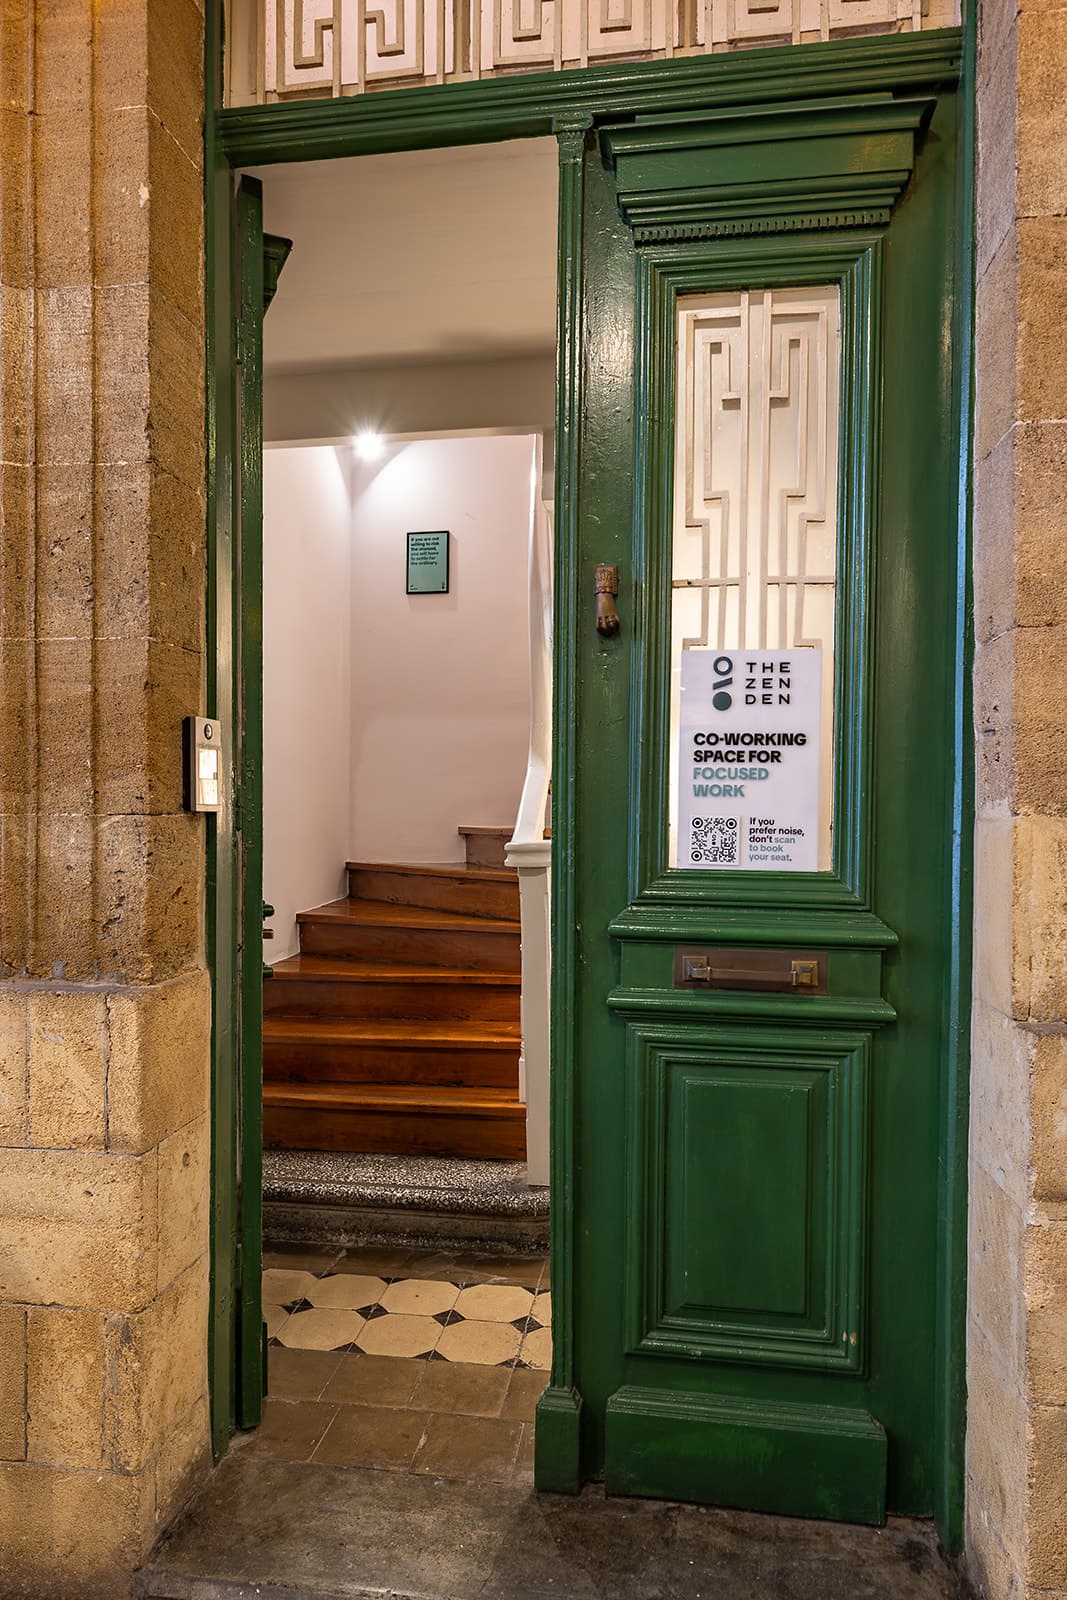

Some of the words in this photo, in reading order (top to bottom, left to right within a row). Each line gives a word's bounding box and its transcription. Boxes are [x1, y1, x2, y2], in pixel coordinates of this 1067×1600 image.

[746, 662, 790, 673] THE
[746, 678, 790, 689] ZEN
[745, 694, 790, 705] DEN
[693, 733, 807, 746] CO-WORKING
[693, 750, 745, 763] SPACE
[748, 751, 781, 763] FOR
[693, 768, 768, 780] FOCUSED
[693, 784, 744, 797] WORK
[750, 817, 756, 826] If
[758, 819, 775, 827] you
[749, 827, 776, 836] prefer
[778, 827, 805, 836] noise,
[760, 844, 783, 853] book
[771, 853, 792, 862] seat.
